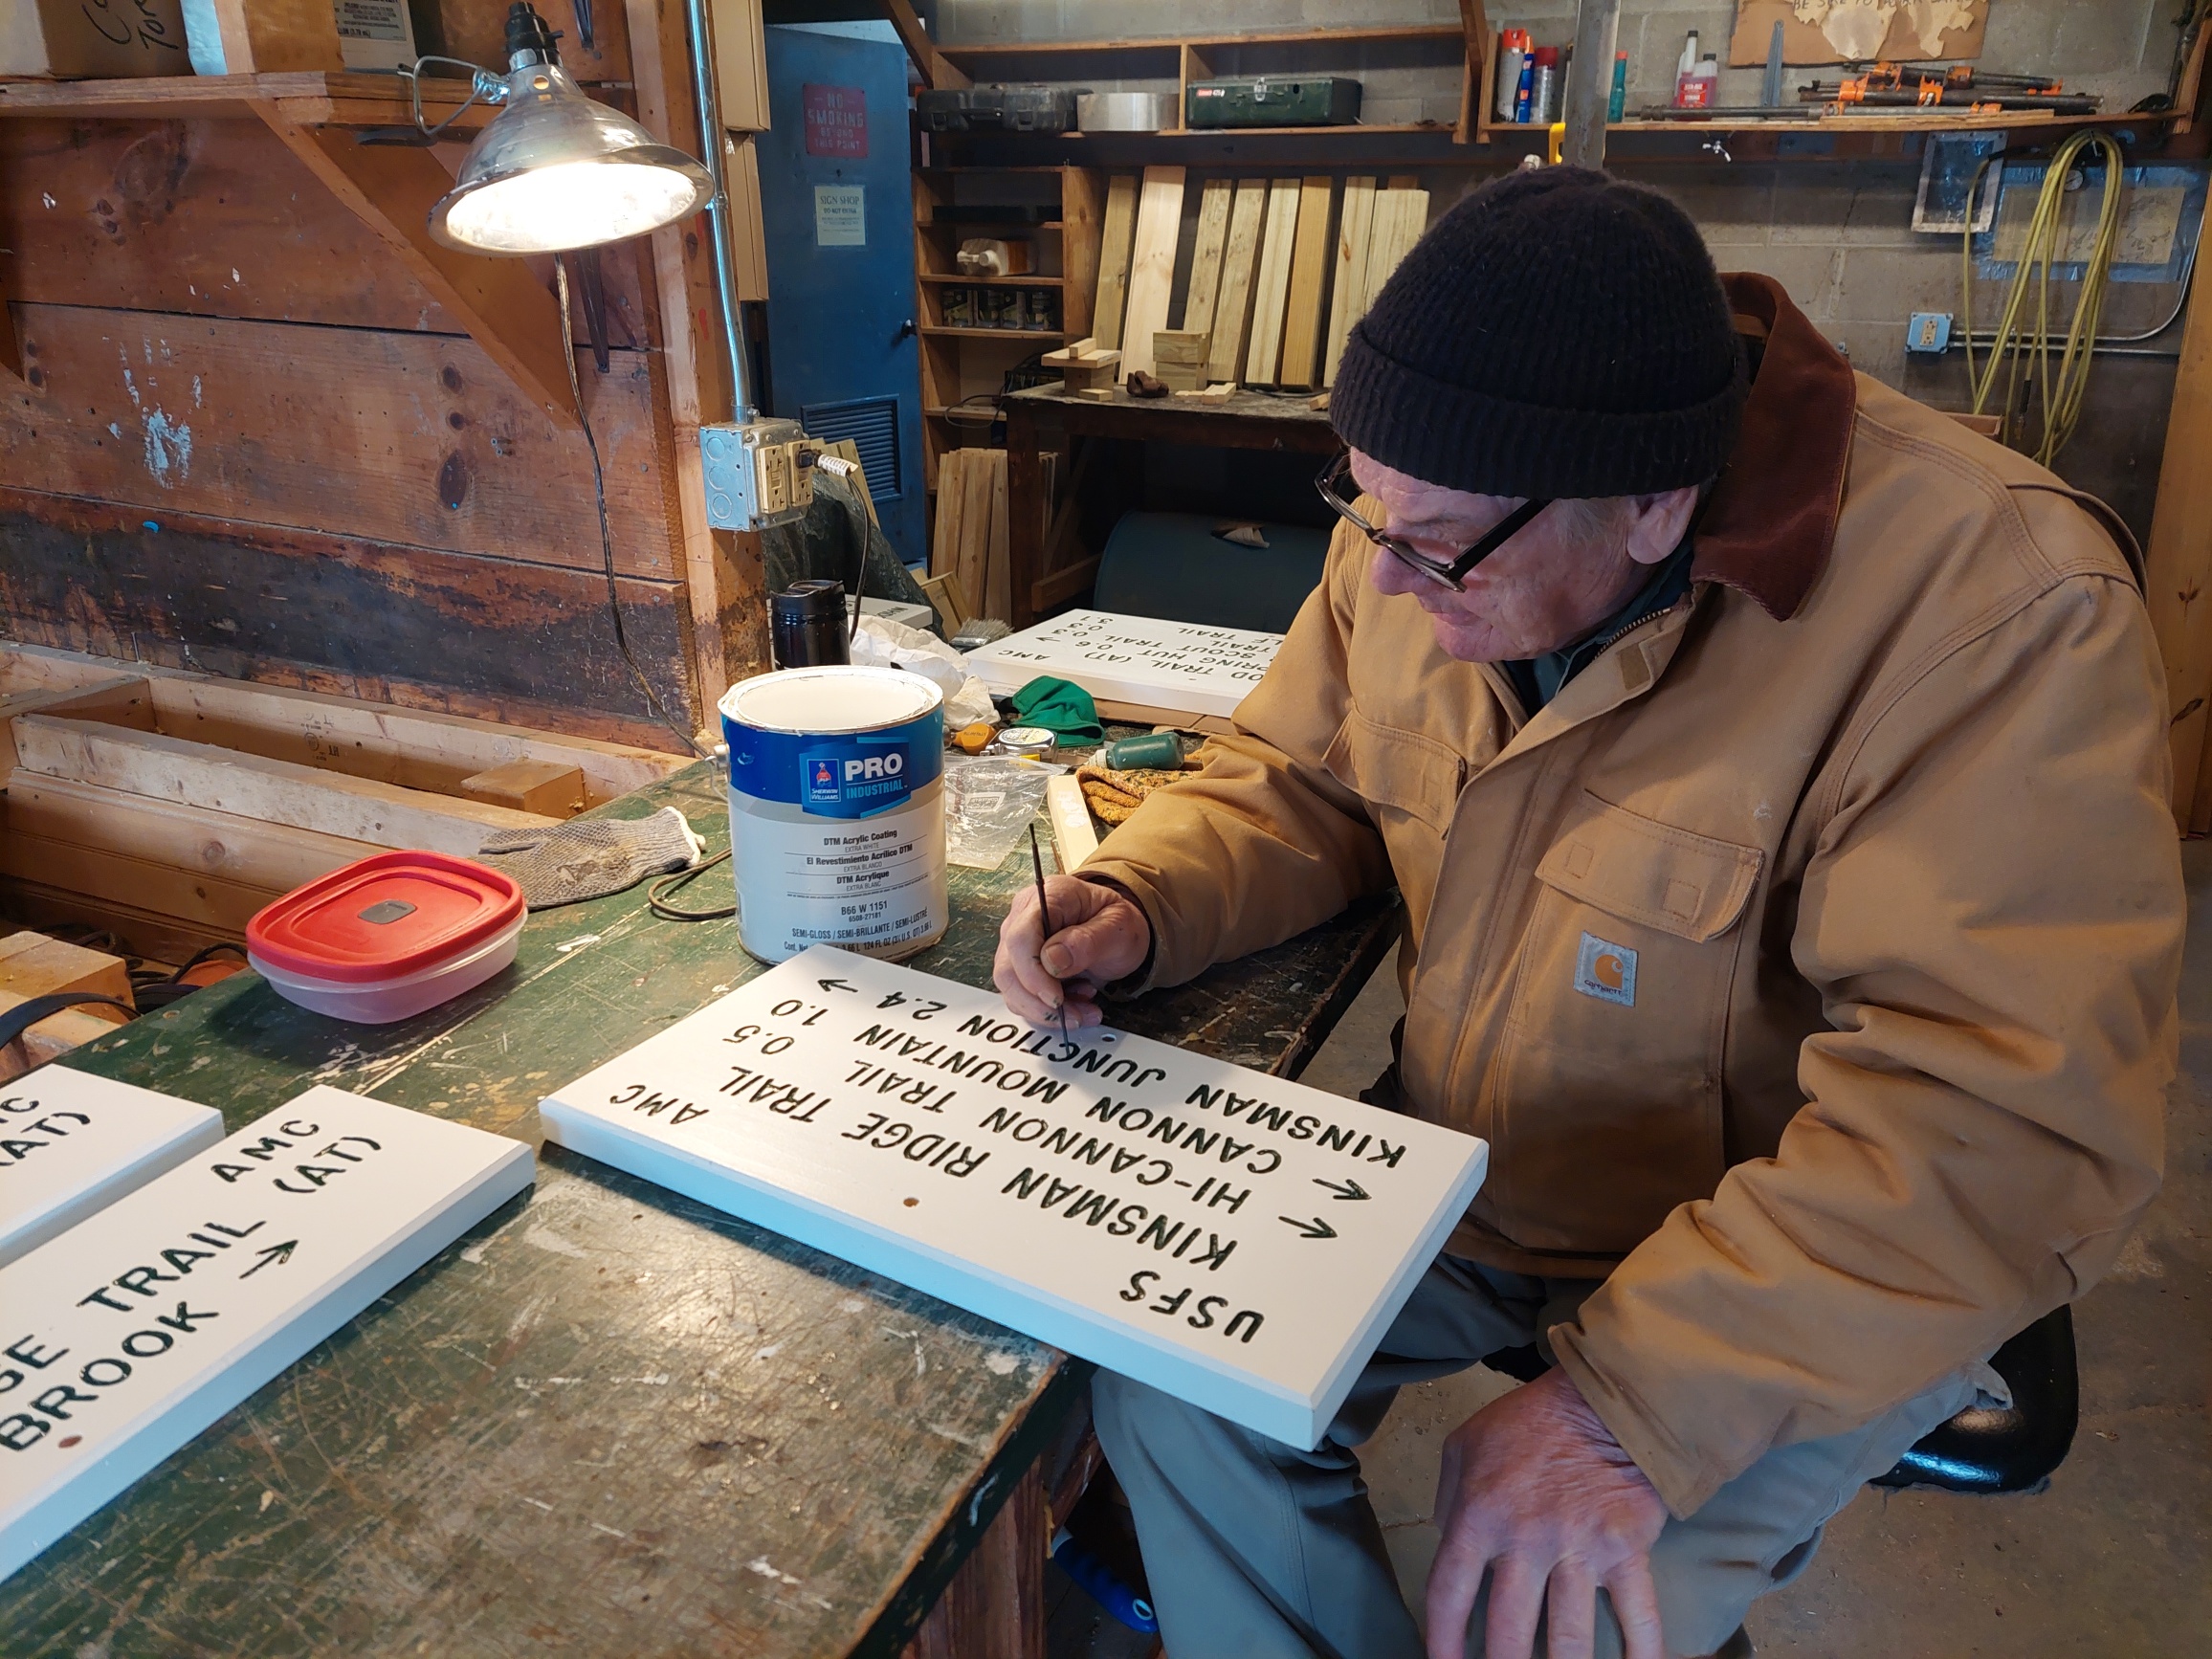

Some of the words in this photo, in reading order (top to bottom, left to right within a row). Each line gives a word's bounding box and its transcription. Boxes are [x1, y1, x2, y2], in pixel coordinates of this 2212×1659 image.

[827, 93, 843, 109] NO
[807, 108, 863, 128] SMOKING
[820, 196, 838, 205] SIGN
[840, 196, 860, 205] SHOP
[1051, 629, 1088, 637] 0.3
[1067, 622, 1103, 631] 0.3
[1178, 627, 1237, 640] TRAIL
[1075, 641, 1113, 650] 0.6
[1105, 635, 1163, 648] TRAIL
[998, 649, 1051, 660] AMC
[1084, 652, 1132, 663] (AT)
[1137, 649, 1187, 660] HUT
[1176, 645, 1256, 659] SCOUT
[1150, 659, 1214, 675] TRAIL
[1199, 657, 1269, 671] PRING
[1230, 671, 1264, 681] OD
[844, 753, 903, 781] PRO
[846, 779, 904, 799] INDUSTRIAL
[843, 835, 870, 845] Acrylic
[871, 830, 897, 841] Coating
[816, 856, 869, 865] Revestimiento
[899, 844, 913, 854] DTM
[844, 864, 861, 872] EXTRA
[862, 861, 883, 870] BLANCO
[837, 876, 853, 884] DTM
[855, 870, 890, 883] Acrylique
[846, 884, 863, 892] EXTRA
[841, 906, 856, 915] B66
[859, 904, 867, 913] W
[869, 900, 888, 910] 1151
[792, 928, 831, 939] SEMI-GLOSS
[833, 930, 835, 940] /
[837, 922, 891, 938] SEMI-BRILLANTE
[891, 921, 894, 931] /
[895, 906, 928, 930] SEMI-LUSTRÉ
[849, 912, 881, 922] 6508-27181
[784, 941, 797, 951] Cont.
[857, 942, 860, 951] L
[863, 941, 874, 950] 124
[875, 939, 882, 949] FL
[884, 937, 891, 946] OZ
[1584, 979, 1623, 996] carhartt
[770, 999, 829, 1026] 1.0
[876, 991, 948, 1020] 2.4
[722, 1025, 795, 1055] 0.5
[957, 1015, 1166, 1087] JUNCTION
[853, 1024, 1071, 1104] MOUNTAIN
[719, 1066, 831, 1123] TRAIL
[844, 1059, 957, 1113] TRAIL
[609, 1084, 710, 1125] AMC
[1085, 1096, 1282, 1174] CANNON
[1184, 1084, 1407, 1168] KINSMAN
[0, 1113, 90, 1166] AT)
[841, 1112, 991, 1177] RIDGE
[210, 1119, 321, 1183] AMC
[978, 1107, 1252, 1214] HI-CANNON
[76, 1221, 267, 1312] TRAIL
[273, 1136, 382, 1194] (AT)
[1001, 1167, 1238, 1271] KINSMAN
[1119, 1271, 1265, 1343] USFS
[0, 1301, 220, 1452] BROOK
